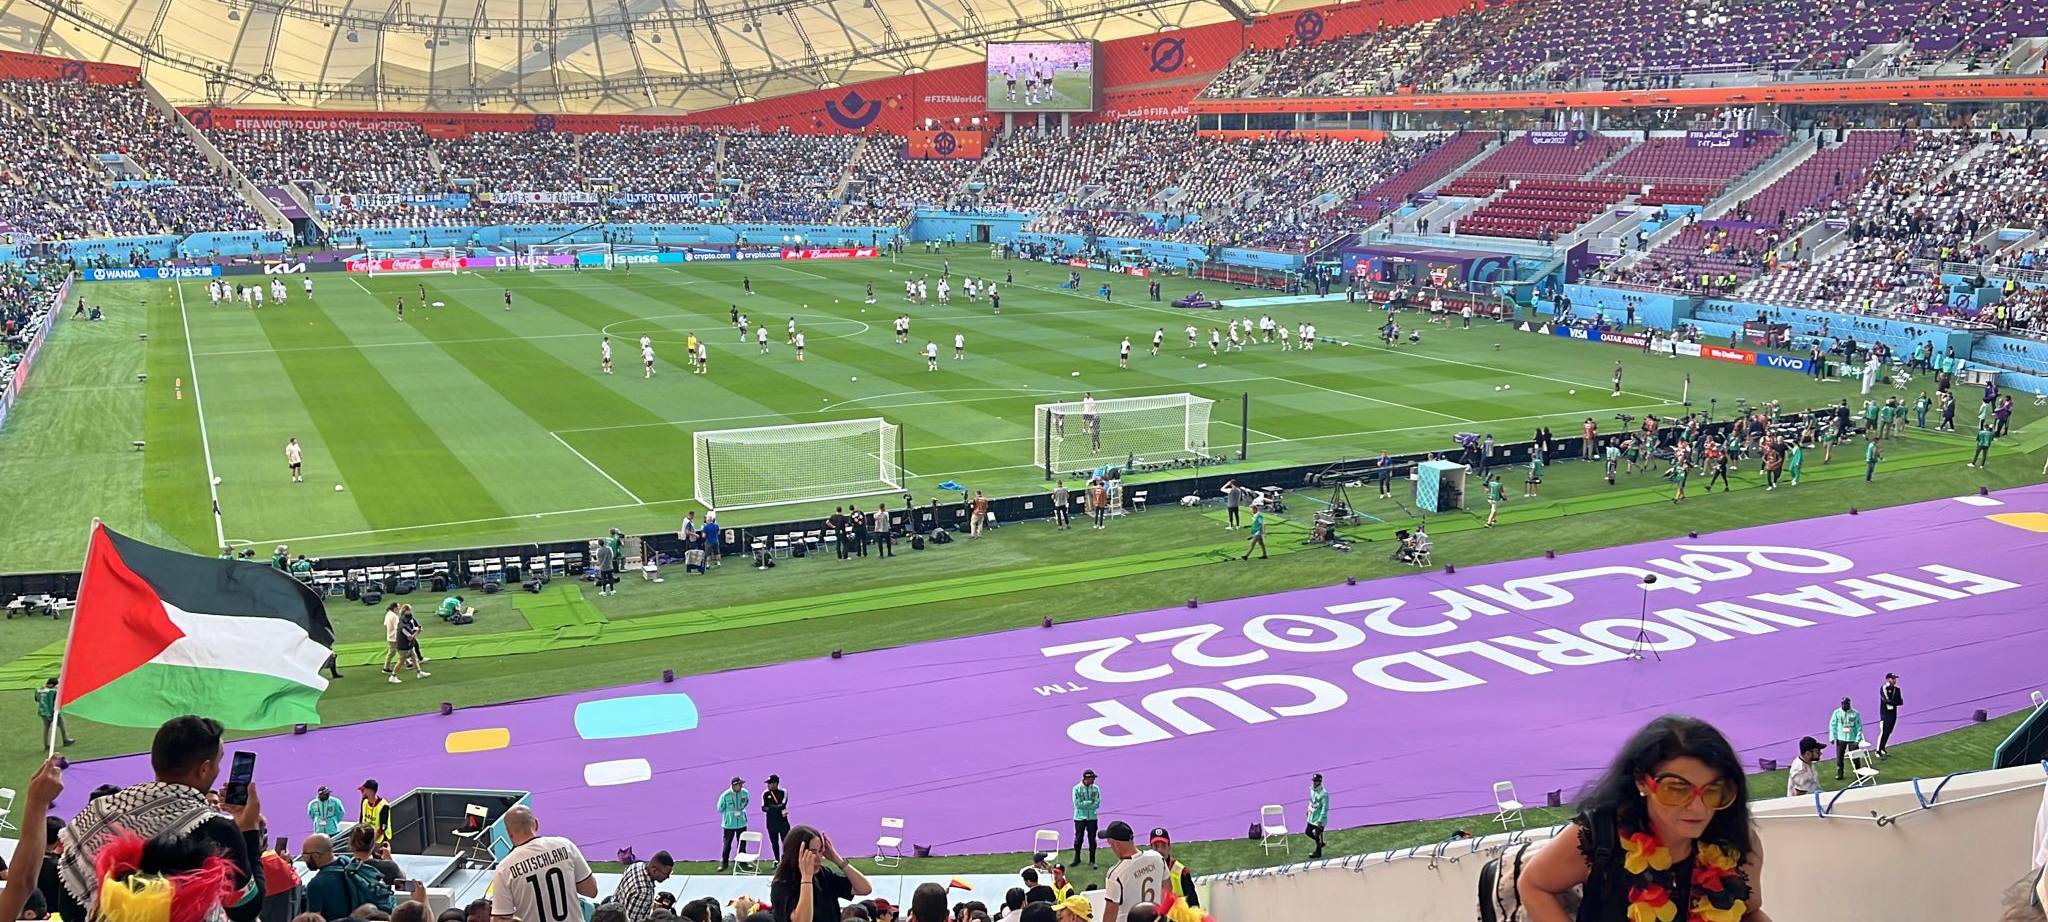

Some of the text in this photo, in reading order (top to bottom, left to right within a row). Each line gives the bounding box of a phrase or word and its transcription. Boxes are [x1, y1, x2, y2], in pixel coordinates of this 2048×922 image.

[235, 119, 261, 129] FIFA
[305, 119, 328, 129] CUP
[694, 252, 730, 261] crypto.com
[744, 251, 781, 260] crypto.com
[106, 269, 141, 279] WANDA
[1569, 328, 1588, 339] VISA
[1600, 333, 1621, 343] QATAR
[1768, 355, 1803, 369] vivo
[1066, 564, 2023, 747] FIFA WORLD CUP
[509, 846, 569, 879] DEUTSCHLAND
[526, 867, 568, 922] 10
[1142, 876, 1155, 902] 6
